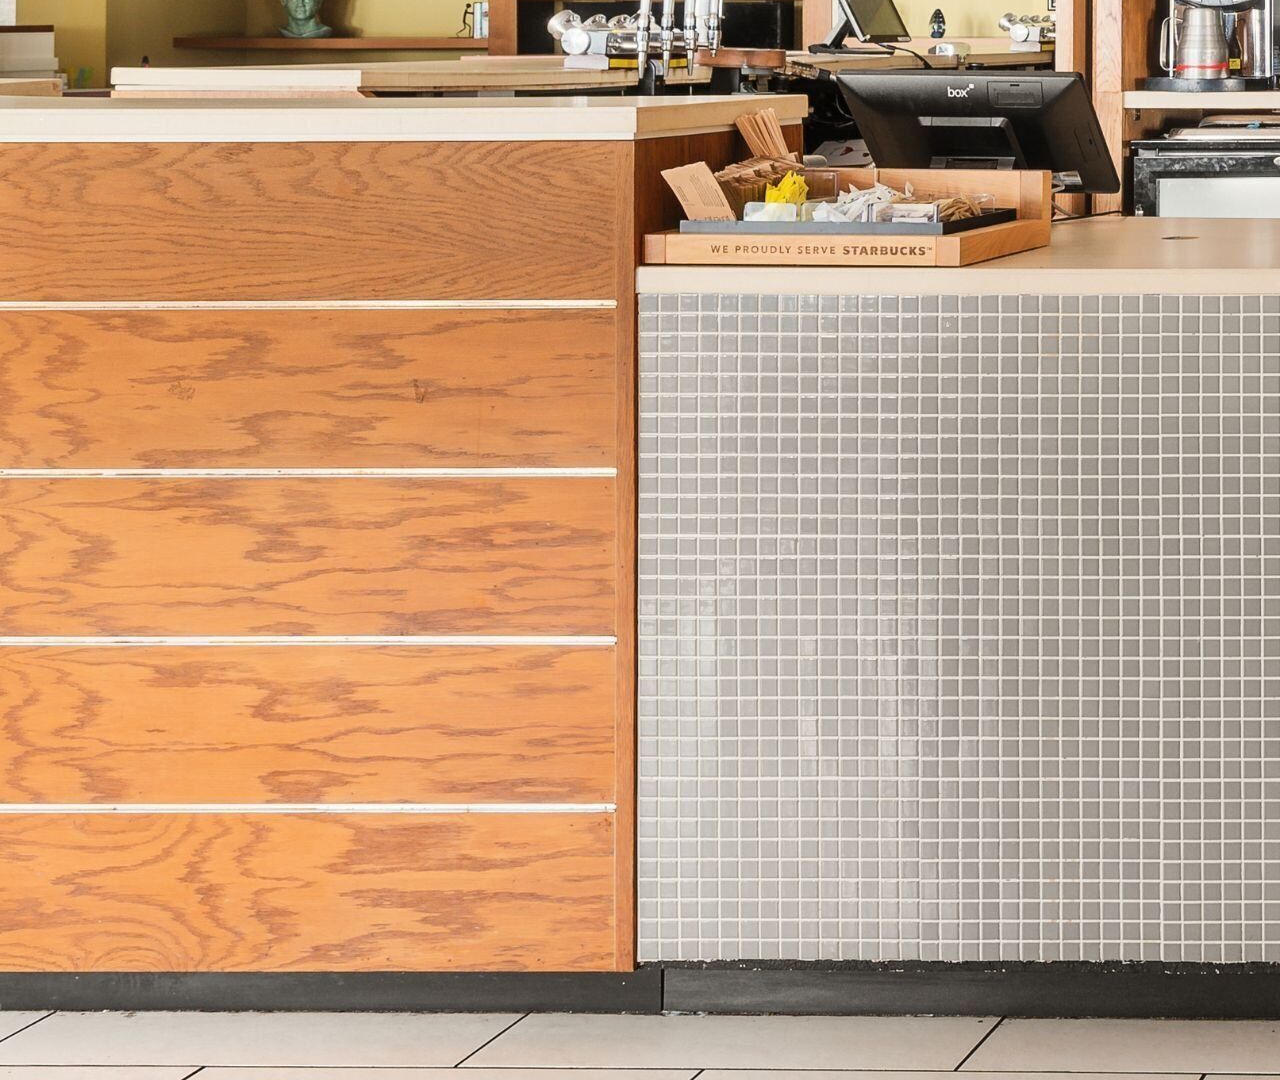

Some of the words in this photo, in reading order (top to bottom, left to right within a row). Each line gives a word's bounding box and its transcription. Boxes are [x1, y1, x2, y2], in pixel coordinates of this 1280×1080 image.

[947, 86, 968, 97] box
[710, 245, 732, 254] WE
[735, 245, 791, 254] PROUDLY
[798, 245, 836, 255] SERVE
